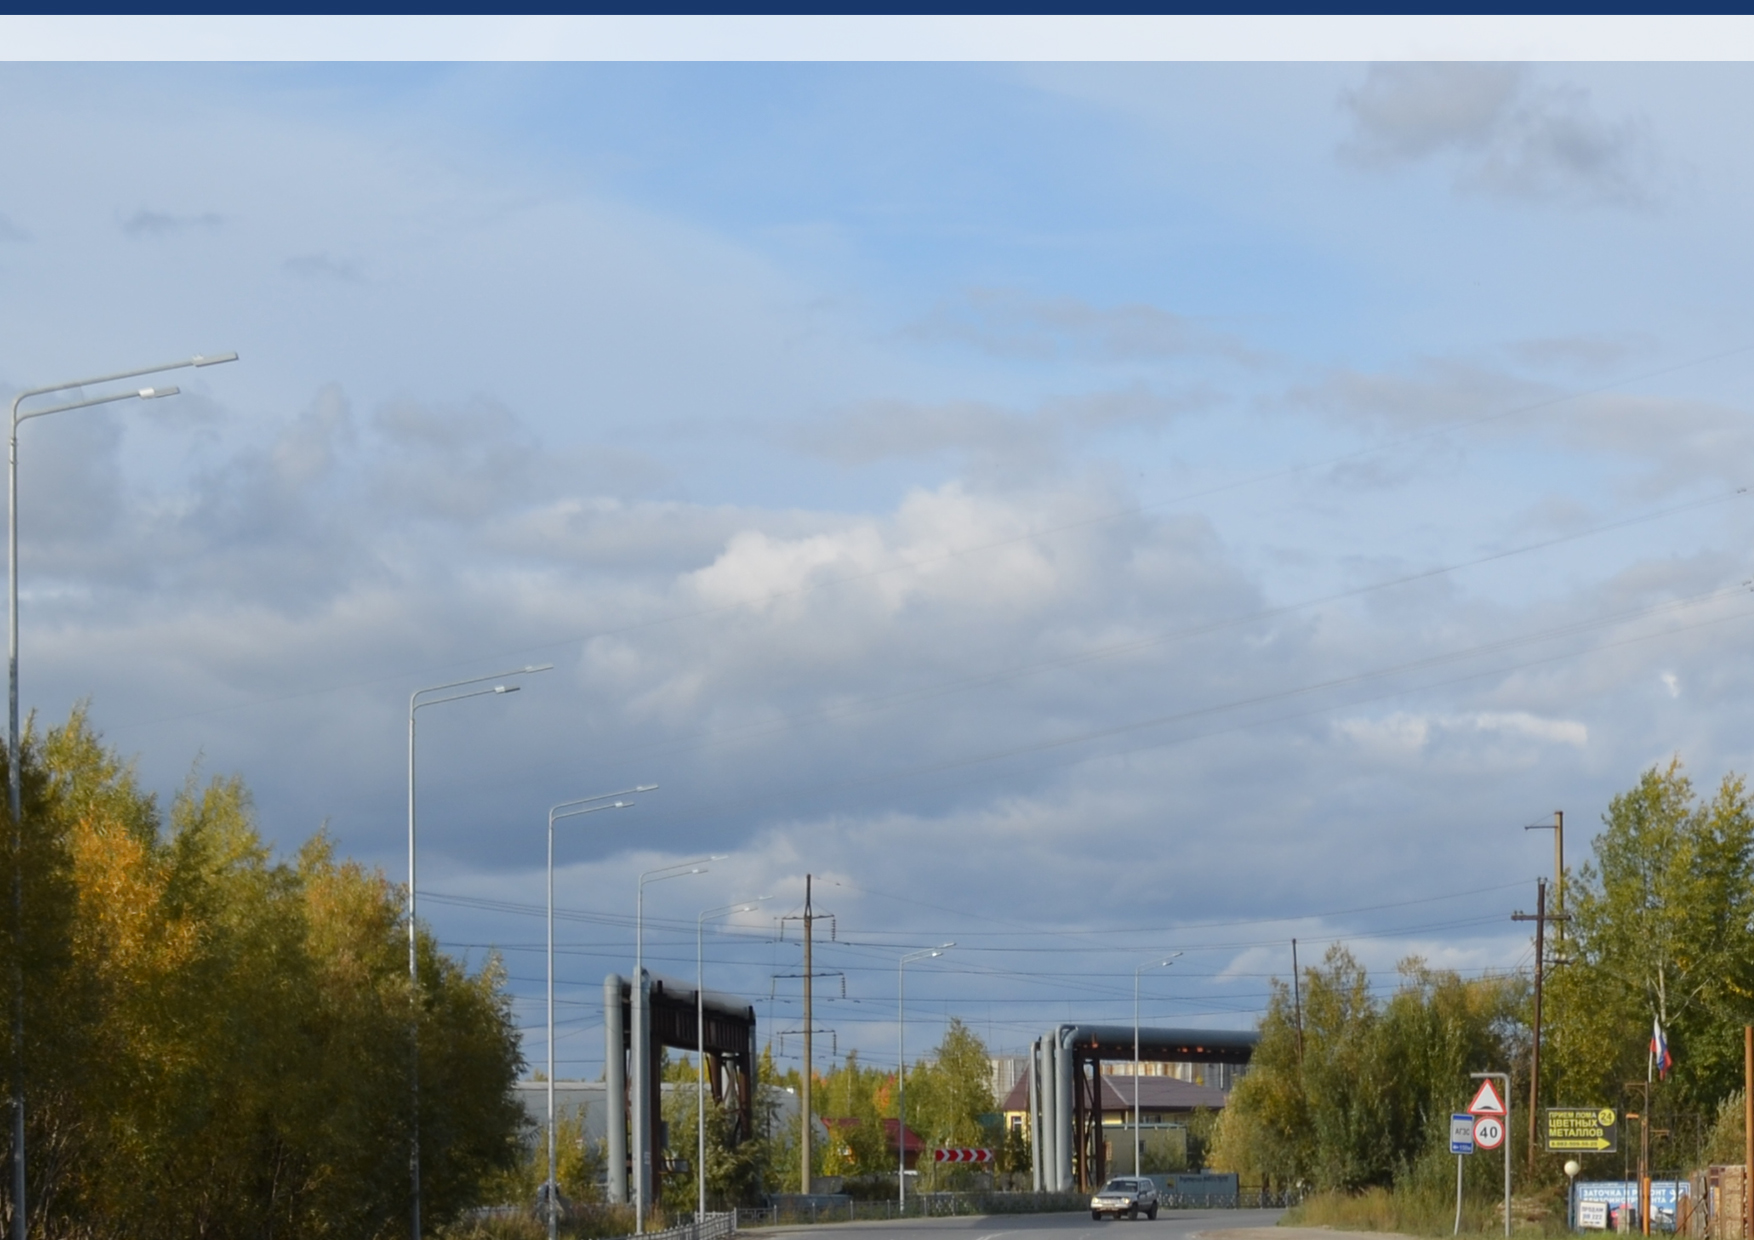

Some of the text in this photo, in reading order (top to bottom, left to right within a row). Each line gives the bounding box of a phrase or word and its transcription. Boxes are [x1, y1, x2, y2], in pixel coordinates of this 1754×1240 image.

[1549, 1119, 1598, 1128] ЦВЕТНЫХ
[1479, 1126, 1498, 1138] 40
[1549, 1128, 1603, 1137] МЕТАЛЛОВ
[1584, 1189, 1619, 1197] ЗАТОЧКА
